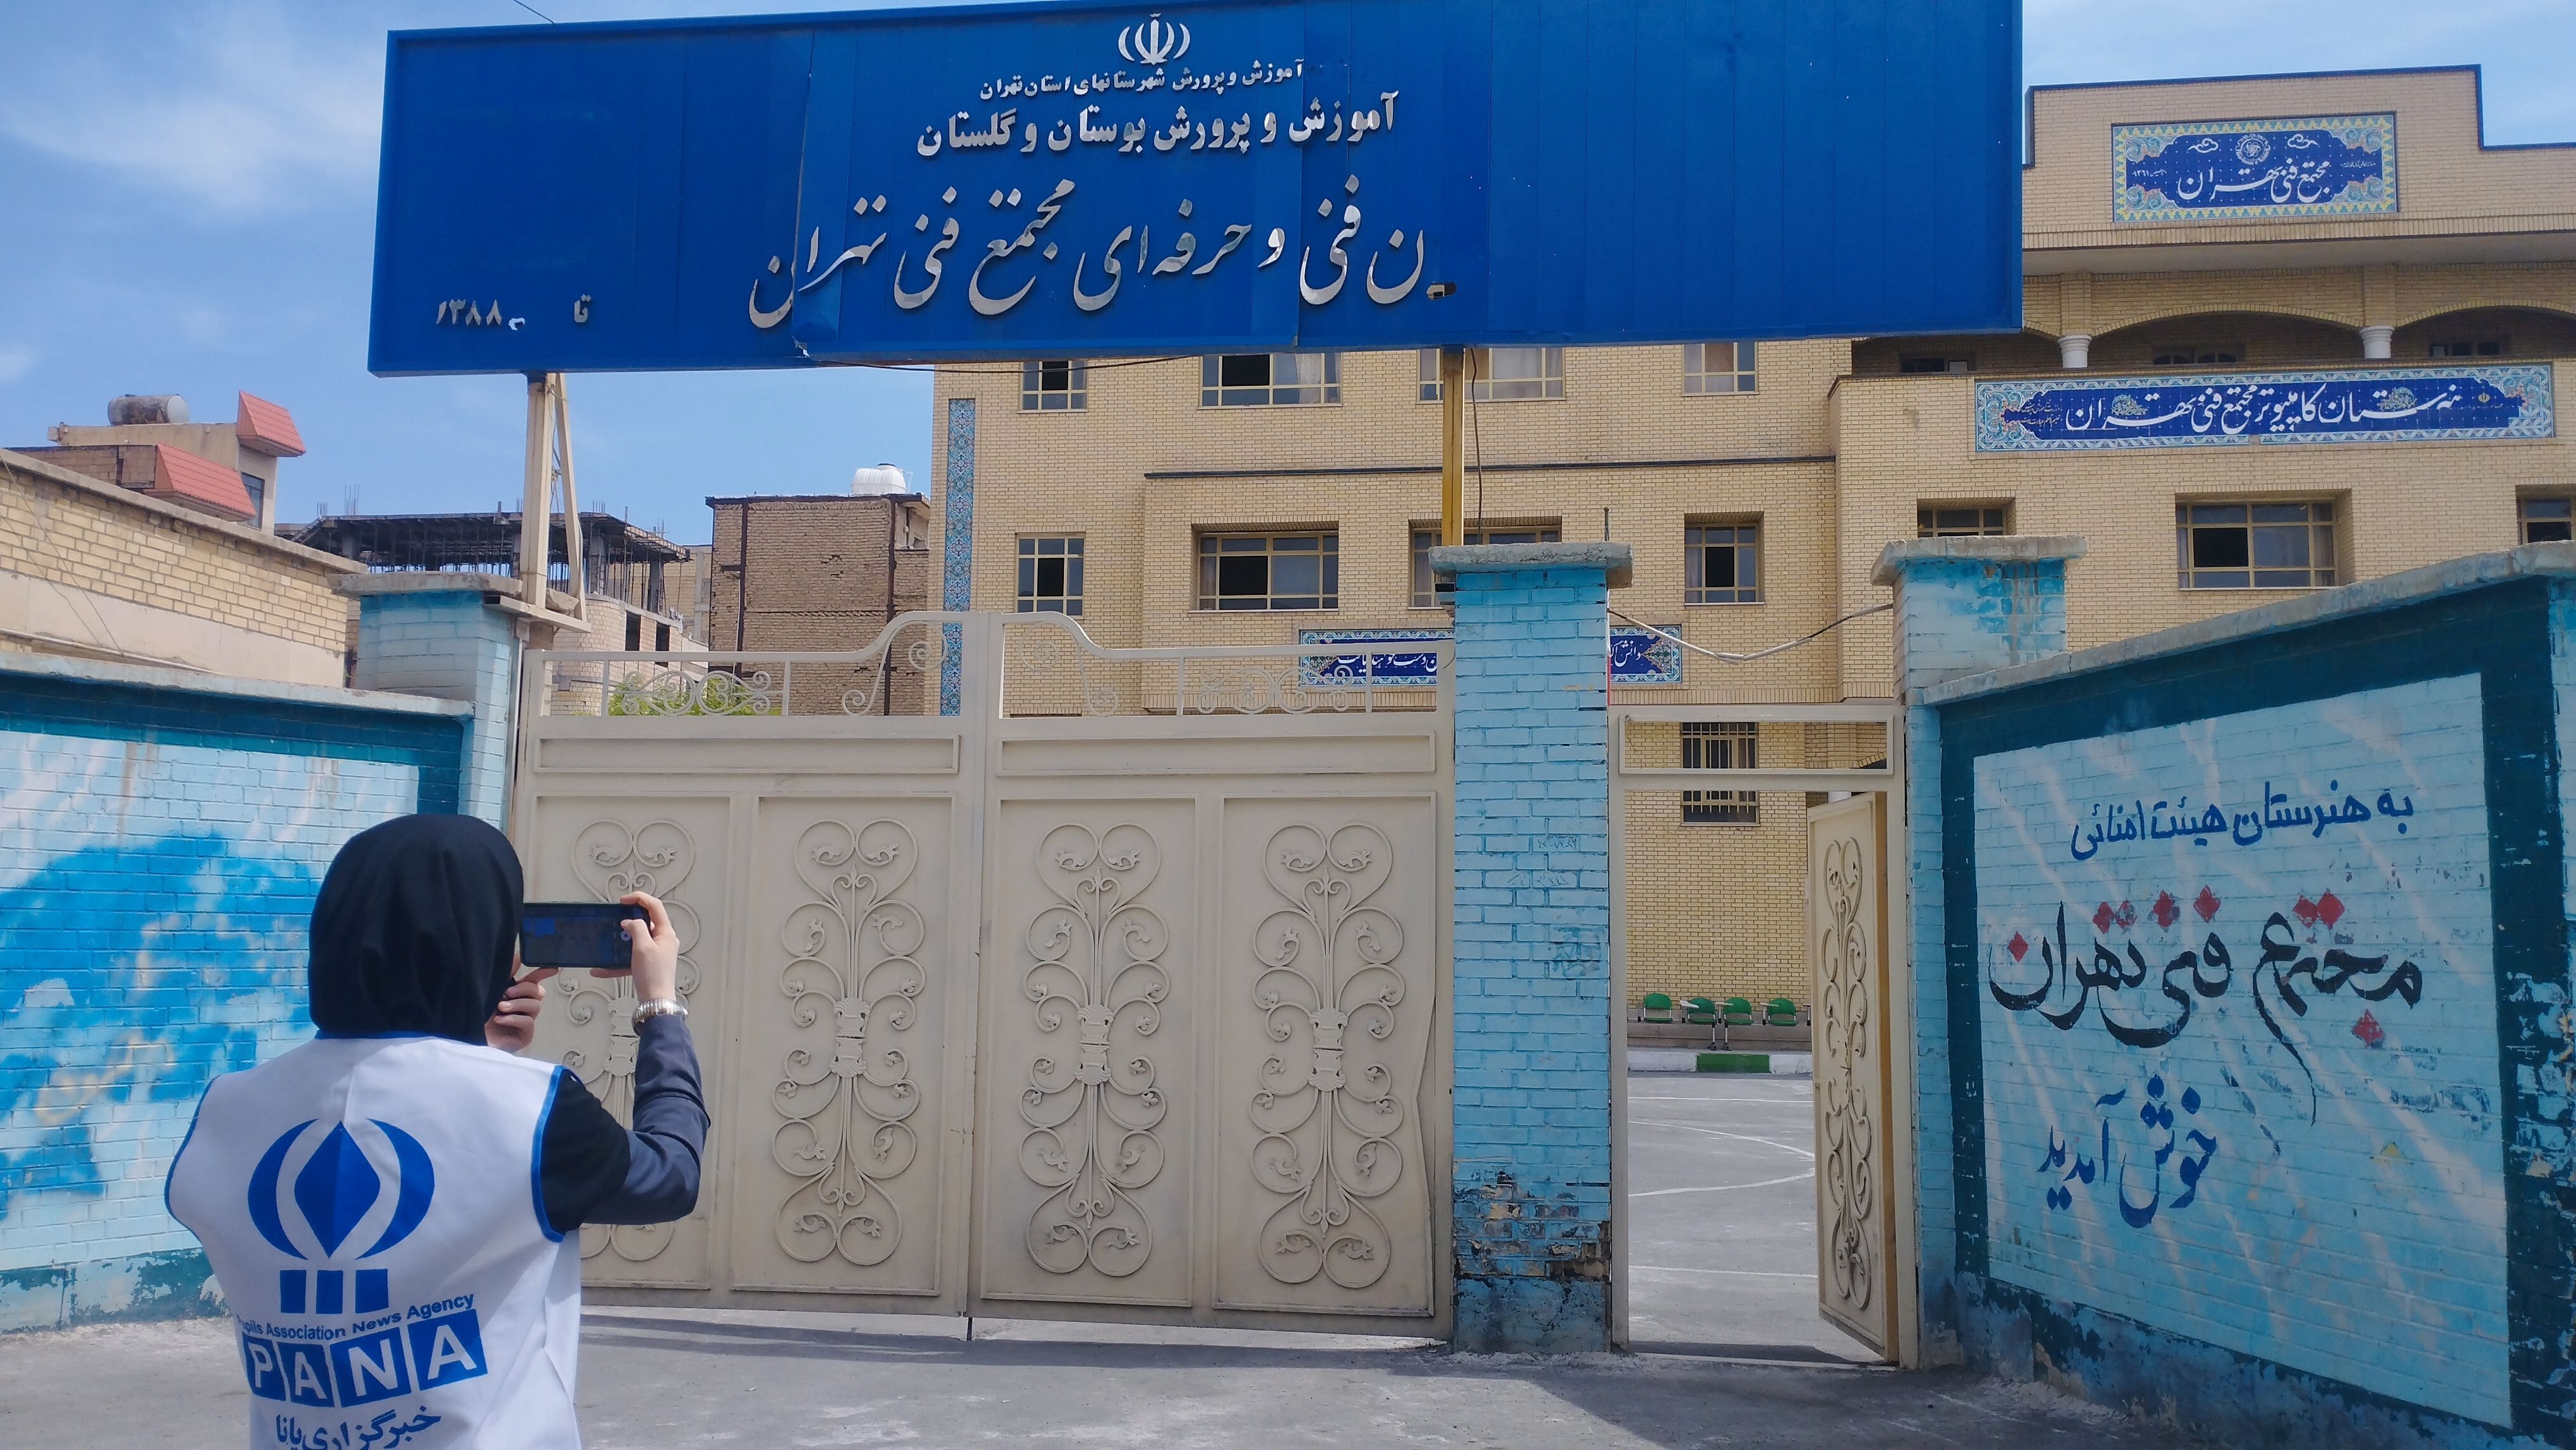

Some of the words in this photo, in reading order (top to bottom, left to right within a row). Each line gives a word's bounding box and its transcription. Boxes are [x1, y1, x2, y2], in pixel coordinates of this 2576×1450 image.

[979, 75, 1023, 100] تهران
[1024, 75, 1071, 97] استان
[1172, 67, 1225, 95] پرورش
[1227, 70, 1237, 86] و
[1242, 59, 1304, 87] آموزش
[917, 107, 1018, 157] گلستان
[1020, 122, 1038, 153] و
[1048, 104, 1146, 153] بوستان
[1154, 105, 1251, 153] پرورش
[1260, 111, 1277, 143] و
[1289, 90, 1399, 143] آموزش
[749, 195, 887, 329] تهران
[894, 186, 960, 309] فنی
[969, 179, 1075, 315] مجتمع
[1258, 227, 1285, 268] و
[1299, 174, 1362, 305] فنی
[436, 299, 503, 327] ۱۳۸۸
[2233, 779, 2371, 846] هنرستان
[2377, 788, 2414, 834] به
[1989, 899, 2147, 1031] تهران
[2098, 884, 2233, 1048] فنی
[2253, 887, 2423, 1127] مجتمع
[2037, 1088, 2127, 1211] آمدید
[2119, 1072, 2217, 1228] خوش
[266, 1322, 346, 1341] Association
[352, 1312, 402, 1334] News
[407, 1293, 474, 1320] Agency
[248, 1324, 477, 1399] PANA
